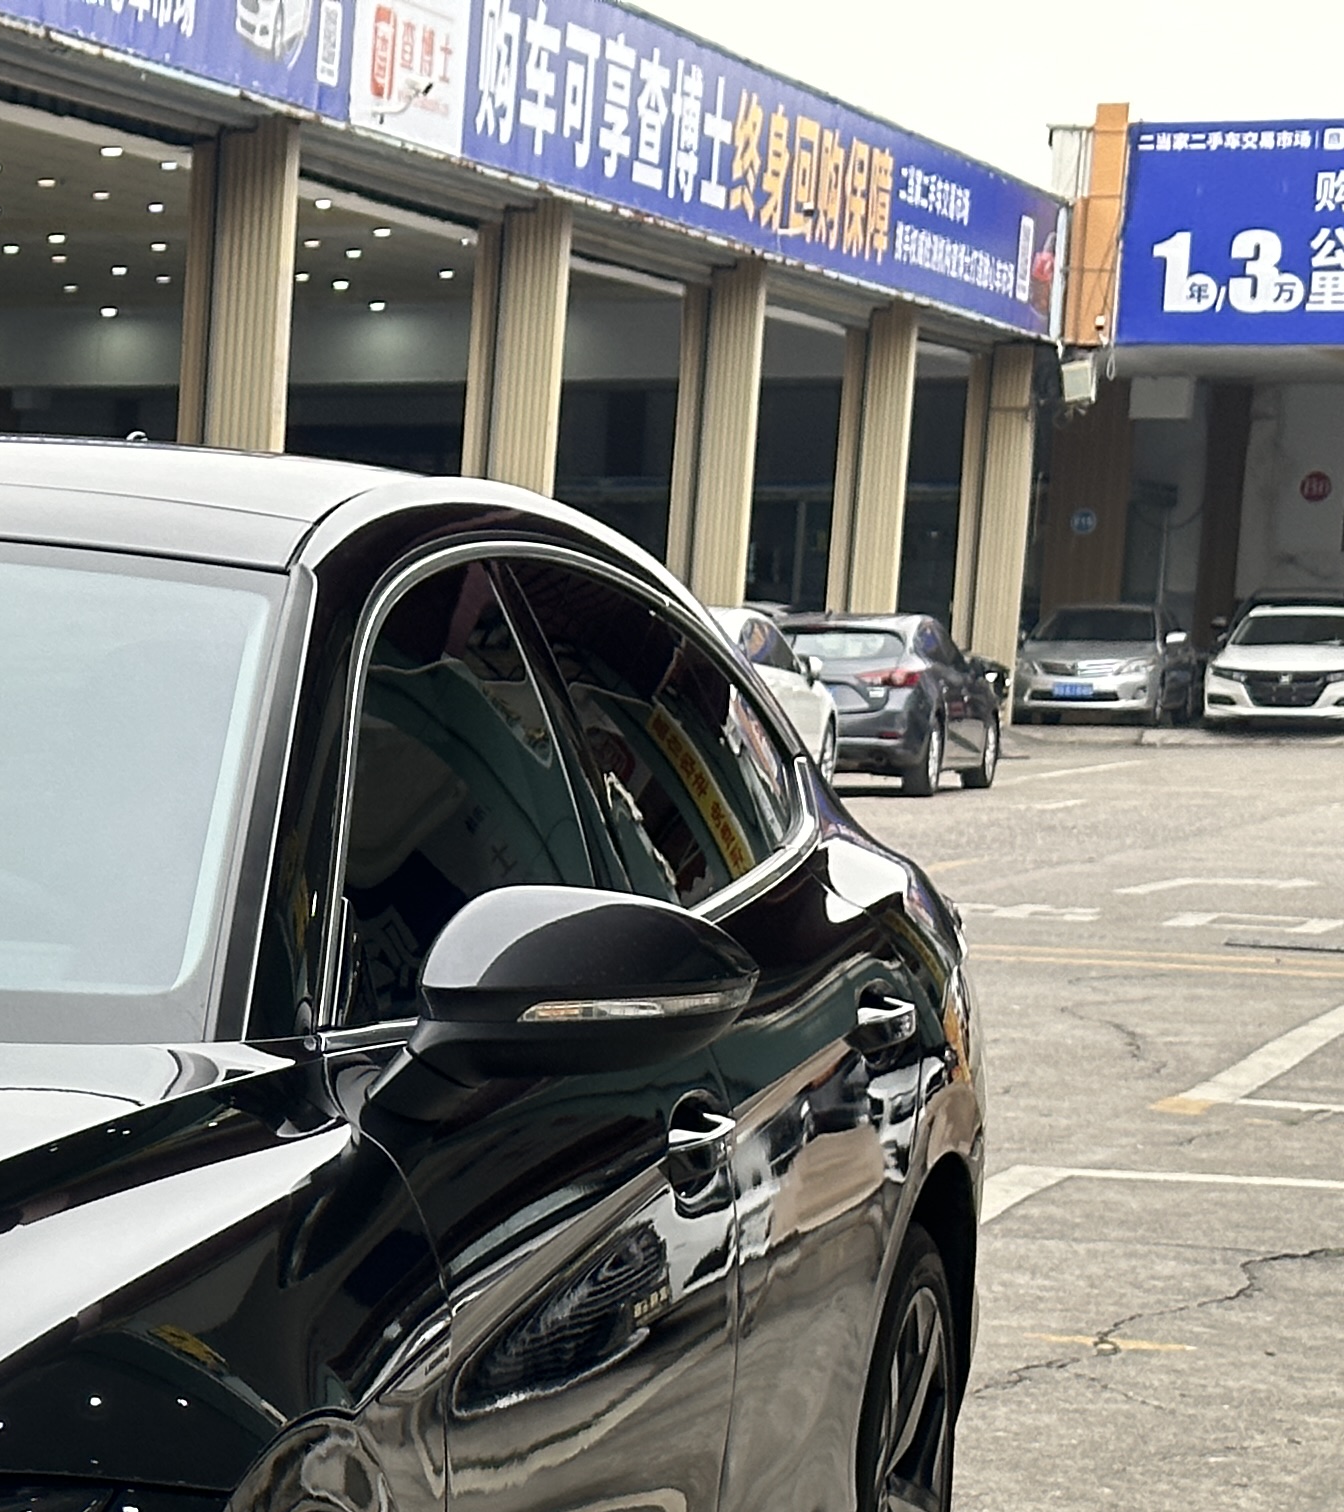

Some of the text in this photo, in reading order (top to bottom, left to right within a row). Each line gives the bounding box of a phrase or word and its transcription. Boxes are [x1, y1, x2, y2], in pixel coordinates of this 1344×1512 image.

[475, 0, 895, 263] 购车可享查博士终身回购保障
